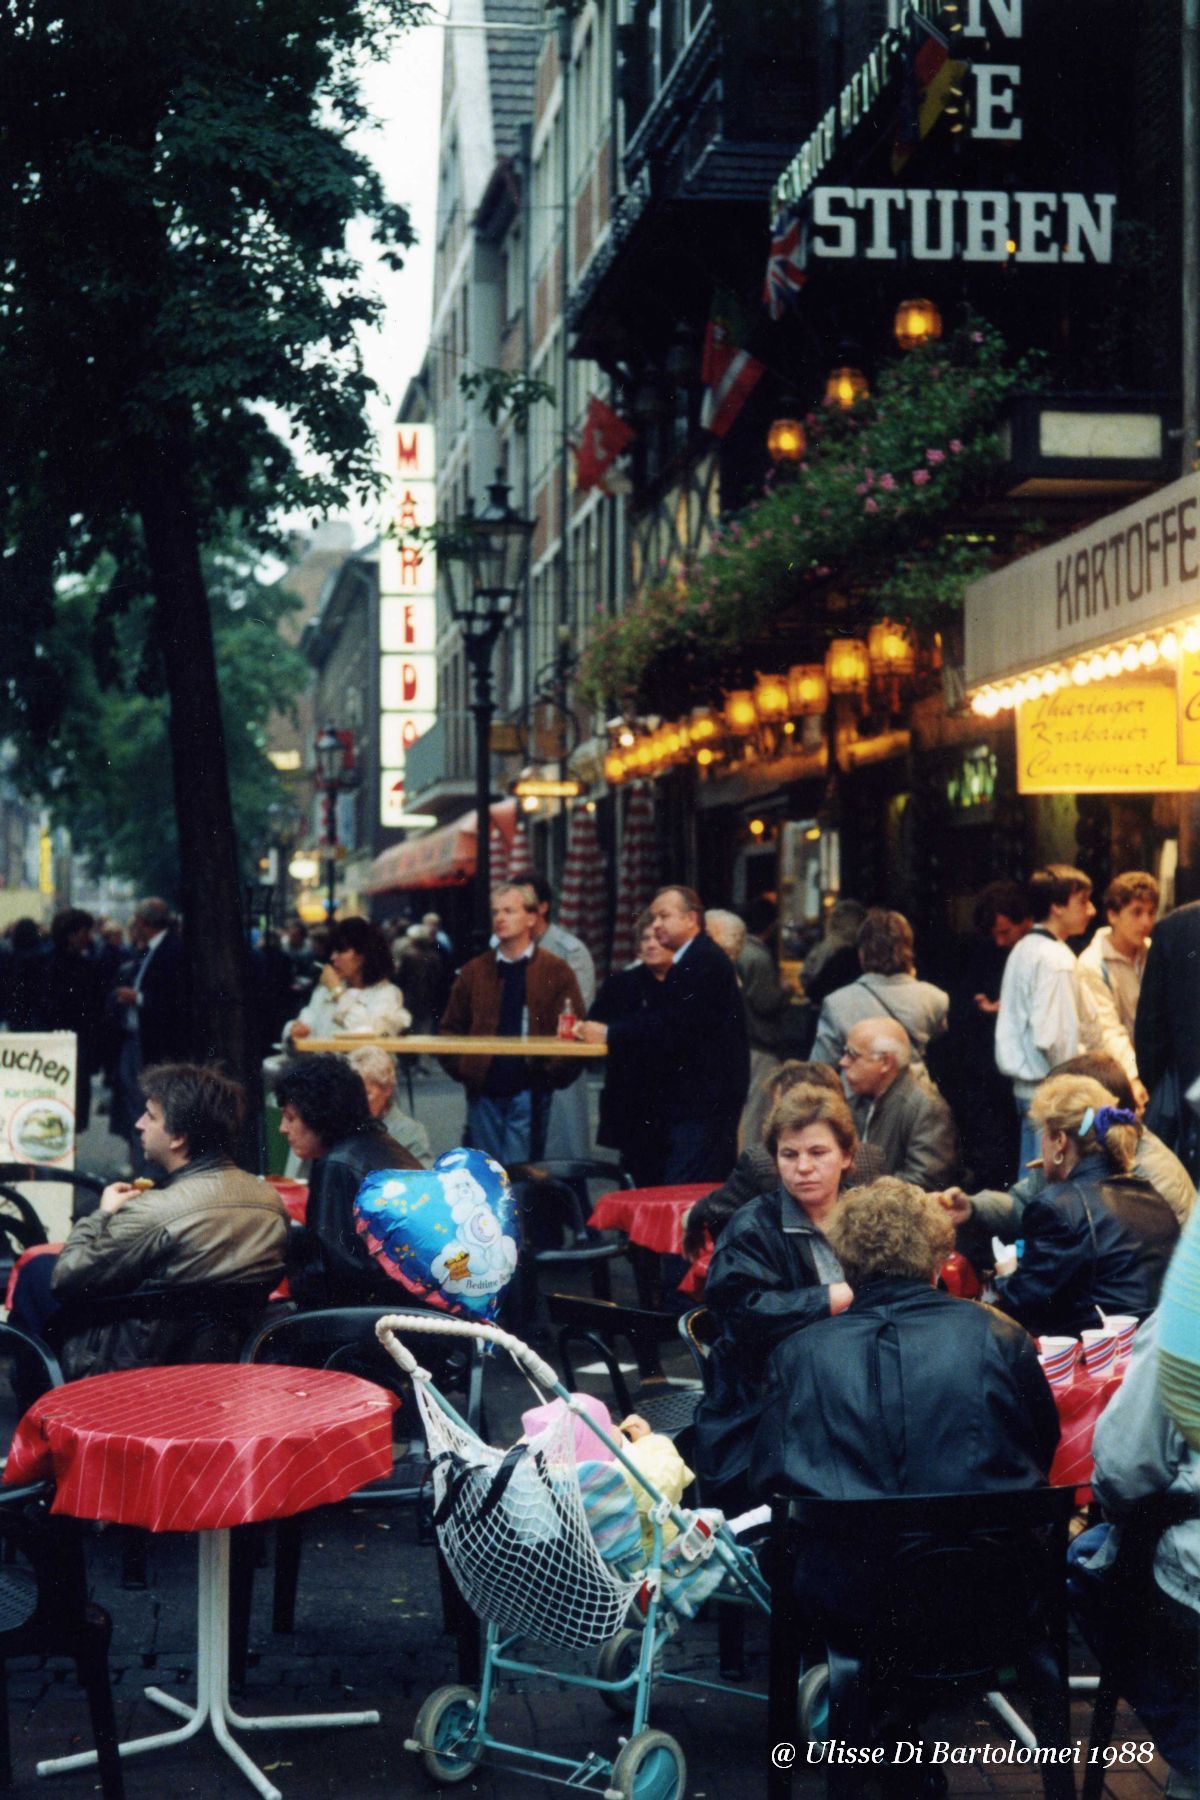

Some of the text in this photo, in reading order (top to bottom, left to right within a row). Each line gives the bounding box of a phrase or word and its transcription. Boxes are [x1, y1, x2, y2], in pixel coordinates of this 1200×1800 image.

[813, 187, 1116, 263] STUBEN
[1056, 496, 1199, 631] KARTOFFE
[0, 1049, 70, 1086] uchen
